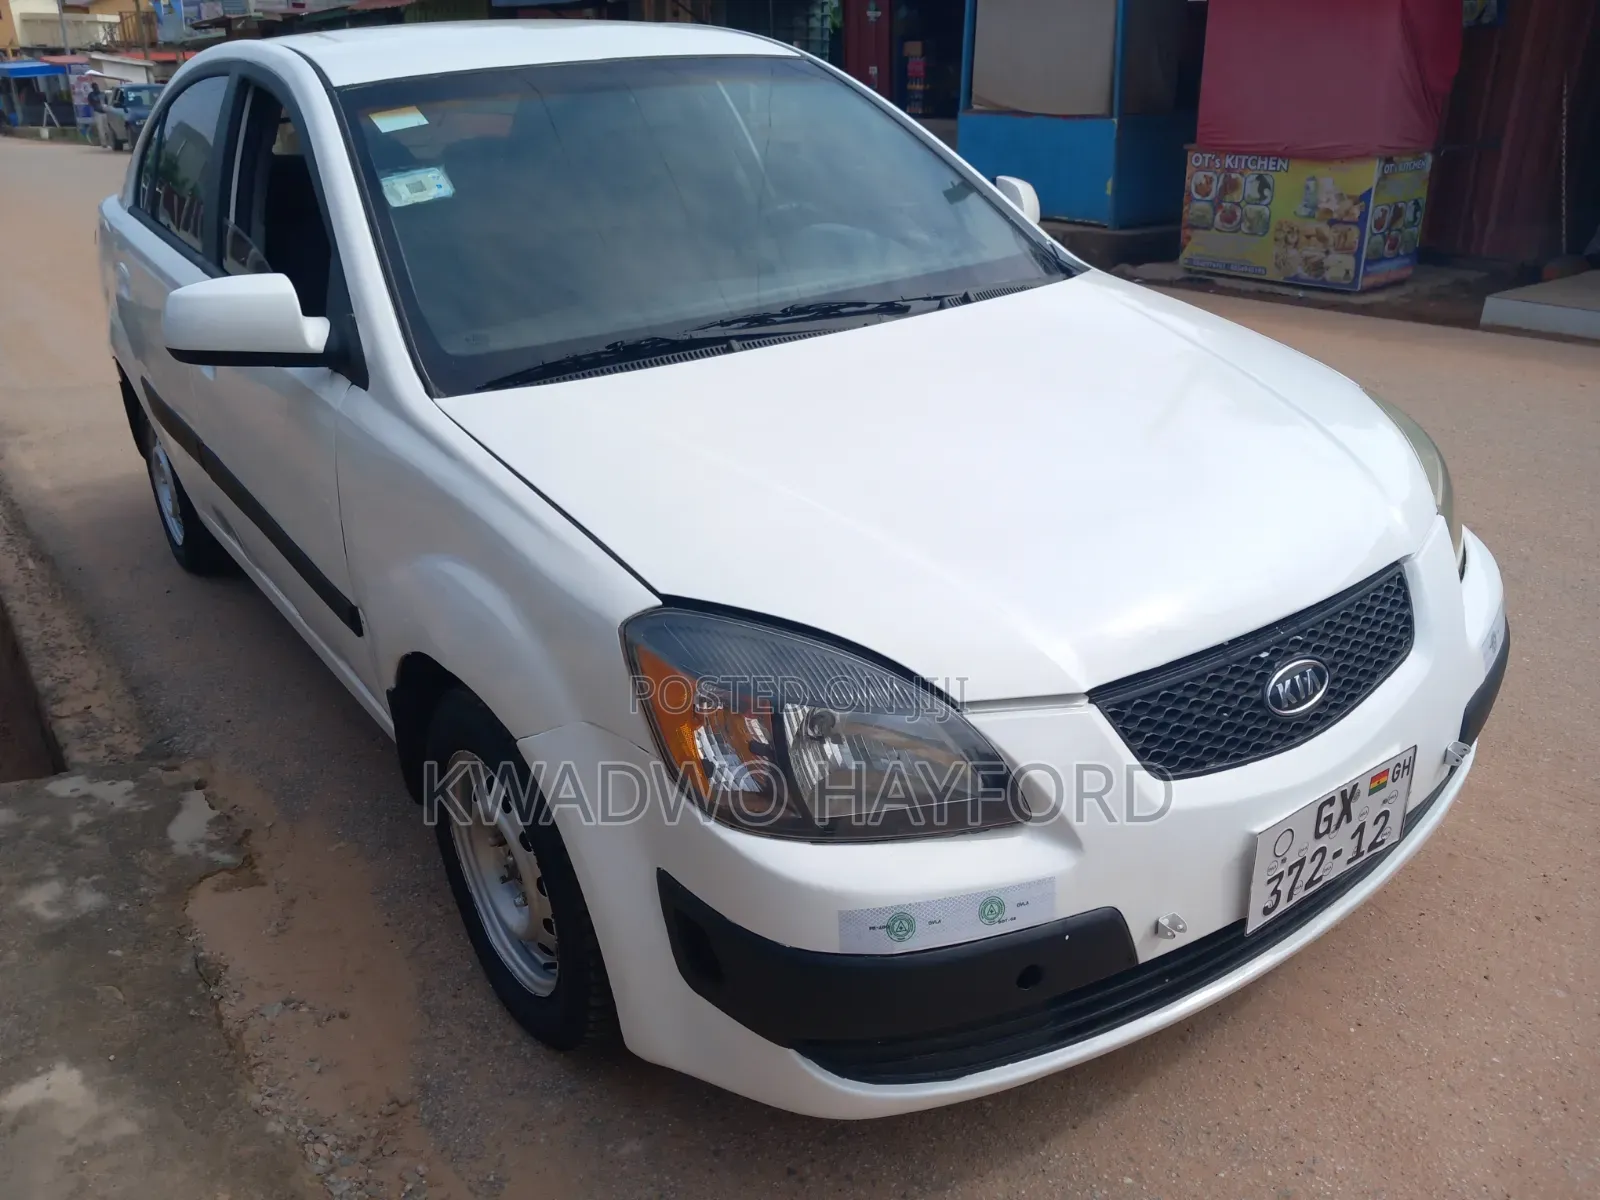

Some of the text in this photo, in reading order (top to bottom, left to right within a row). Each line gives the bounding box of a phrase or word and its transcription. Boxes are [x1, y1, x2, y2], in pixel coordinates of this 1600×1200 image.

[1192, 153, 1289, 171] OT's KITCHEN
[1276, 668, 1321, 709] KIA
[1314, 756, 1412, 840] GX GH
[1262, 809, 1391, 916] 372-12
